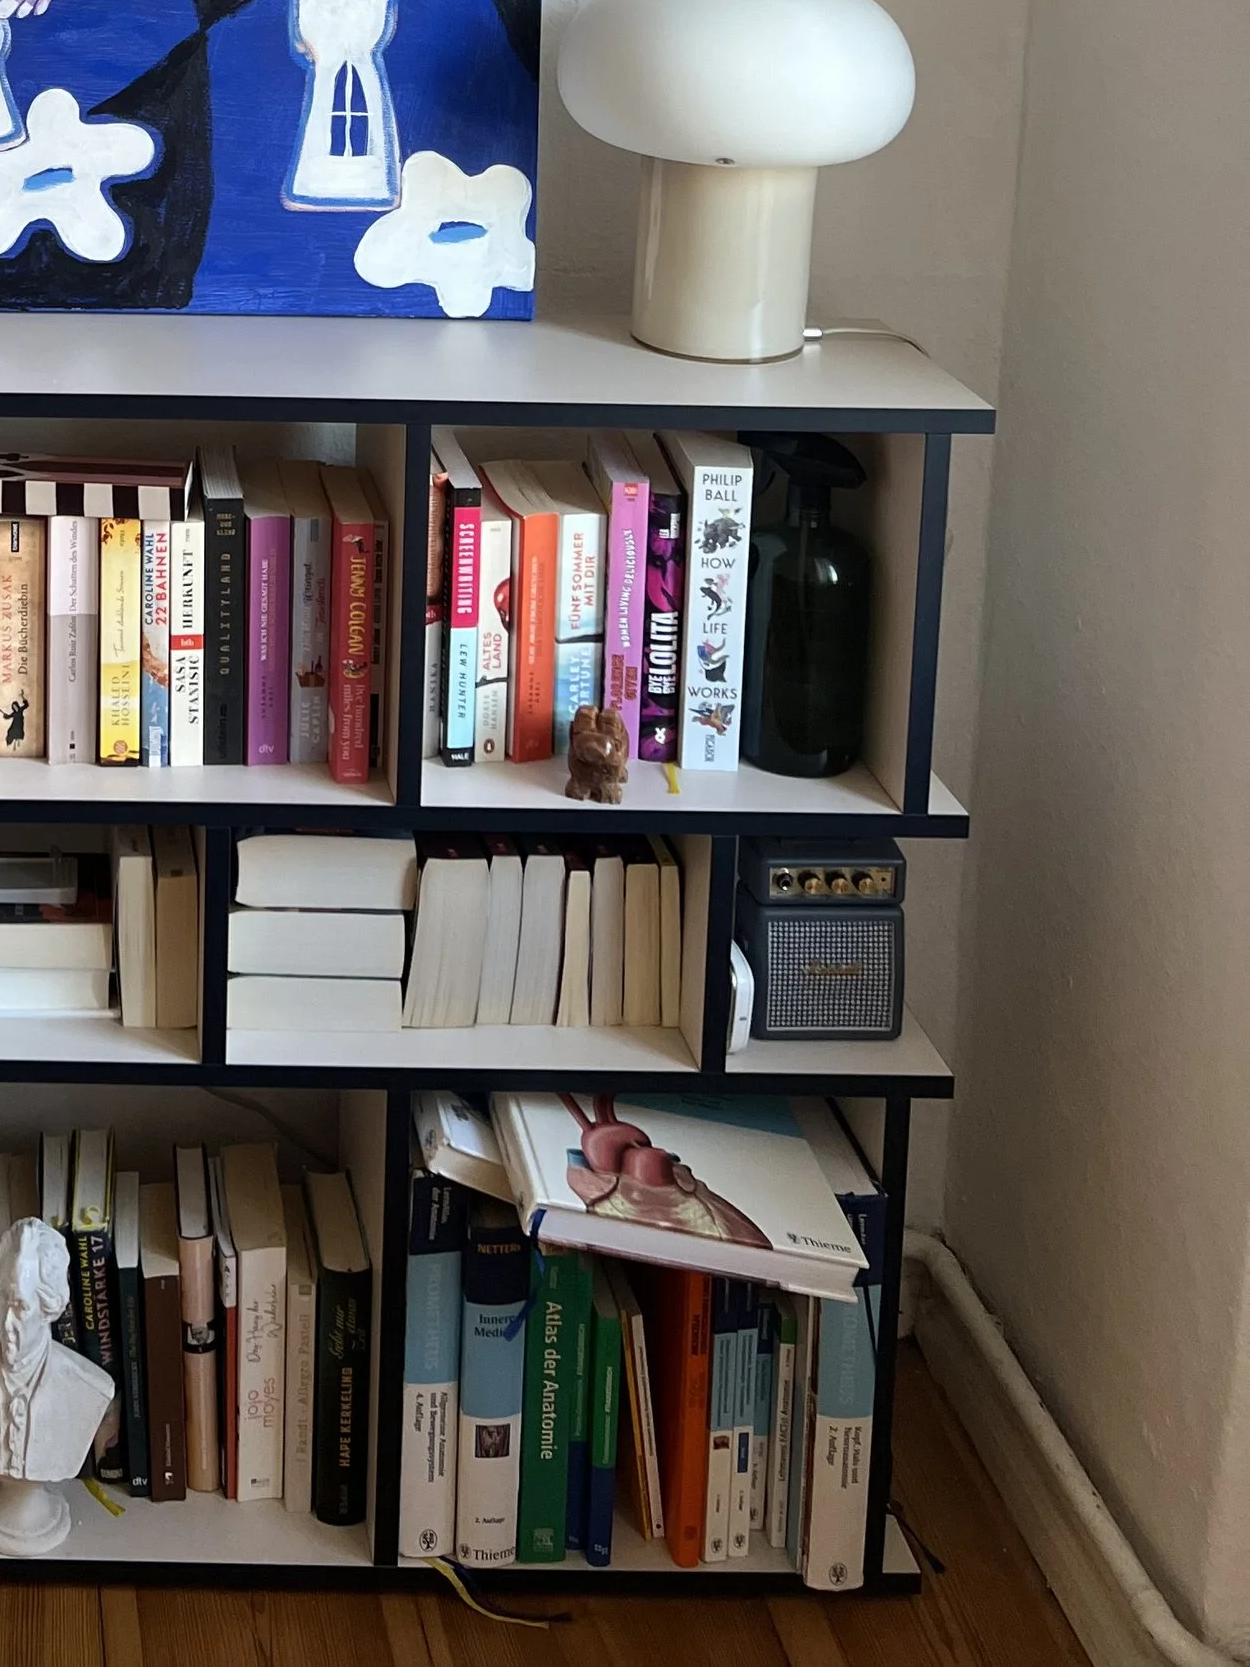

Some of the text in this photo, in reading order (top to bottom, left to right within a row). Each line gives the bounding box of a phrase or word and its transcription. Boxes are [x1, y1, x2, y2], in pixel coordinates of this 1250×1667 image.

[702, 473, 743, 486] PHILIP
[705, 489, 738, 502] BALL
[68, 521, 77, 612] Der Schatten des Windes
[145, 533, 154, 625] CAROLINE WAHL
[156, 533, 167, 625] 22 BAHNEN
[457, 523, 475, 614] SCREENWRITING
[570, 533, 583, 630] FÜNF SOMMER
[584, 555, 595, 606] MIT DIR
[701, 557, 736, 569] HOW
[182, 550, 193, 629] HERKUNFT
[348, 556, 366, 655] JENNY COLGAN
[618, 587, 631, 615] LIVING
[2, 574, 11, 684] MARKUS ZUSAK
[17, 584, 28, 675] Die Bücherdiebin
[219, 552, 231, 675] QUALITYLAND
[619, 616, 630, 647] WOMEN
[702, 623, 728, 635] LIFE
[68, 640, 77, 657] Ruiz
[482, 632, 492, 671] ALTES
[492, 633, 502, 669] LAND
[649, 611, 678, 676] LOLITA
[68, 658, 77, 682] Carlos
[457, 643, 468, 719] LEW HUNTER
[568, 656, 581, 713] CARLEY
[648, 675, 663, 694] BYE
[662, 676, 675, 693] BYE
[687, 686, 738, 700] WORKS
[111, 676, 120, 726] KHALED
[258, 743, 274, 754] dtv
[354, 704, 365, 748] hundred
[90, 1236, 104, 1252] 17
[802, 1236, 852, 1254] Thieme
[78, 1236, 95, 1330] CAROLINE WAHL
[425, 1263, 442, 1370] PROMETHEUS
[261, 1377, 279, 1428] moyes
[540, 1301, 562, 1460] Atlas der Anatomie
[247, 1390, 264, 1420] jojo
[339, 1367, 352, 1467] HAPE KERKELING
[132, 1476, 148, 1487] dtv
[472, 1545, 516, 1562] Thieme
